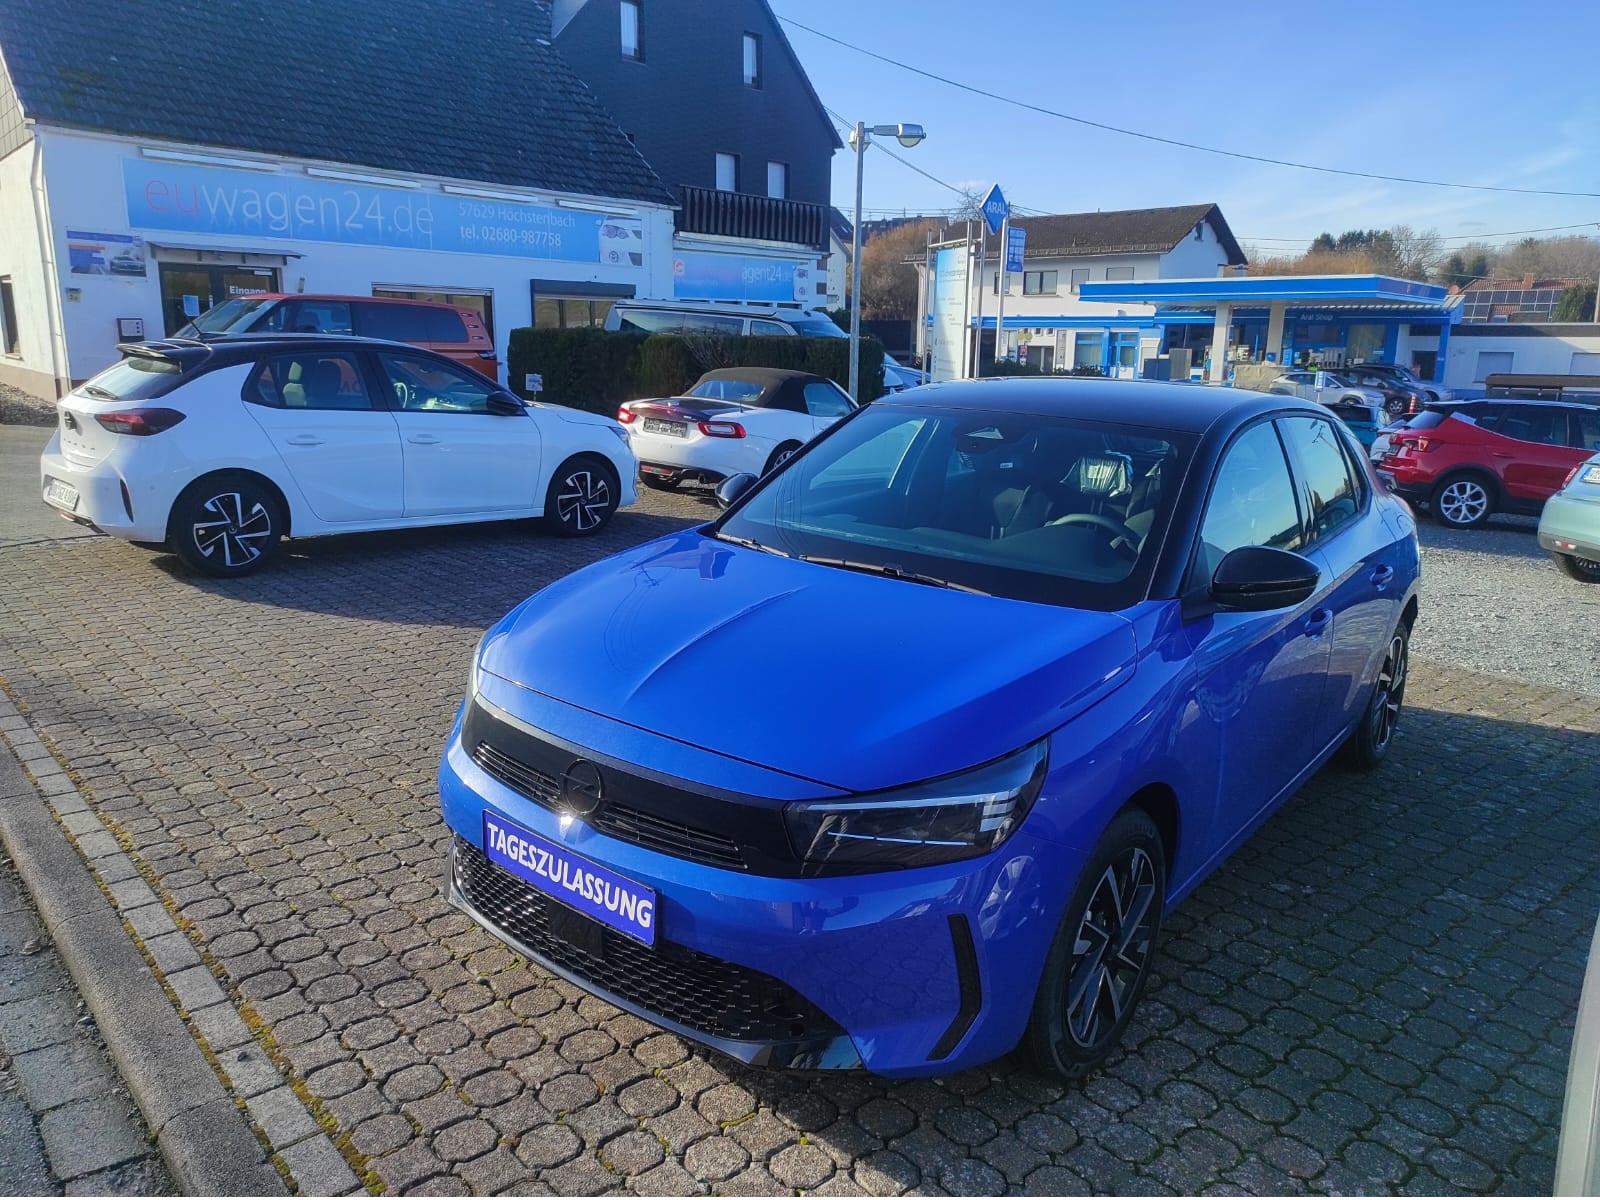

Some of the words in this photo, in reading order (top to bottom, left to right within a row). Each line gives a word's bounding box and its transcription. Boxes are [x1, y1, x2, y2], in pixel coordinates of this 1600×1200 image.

[145, 179, 434, 234] euwagen24.de
[458, 201, 495, 218] 57629
[986, 201, 1007, 216] ARAL
[460, 224, 480, 240] tel.
[481, 225, 561, 247] 02680-987758
[486, 822, 653, 928] TAGESZULASSUNG
